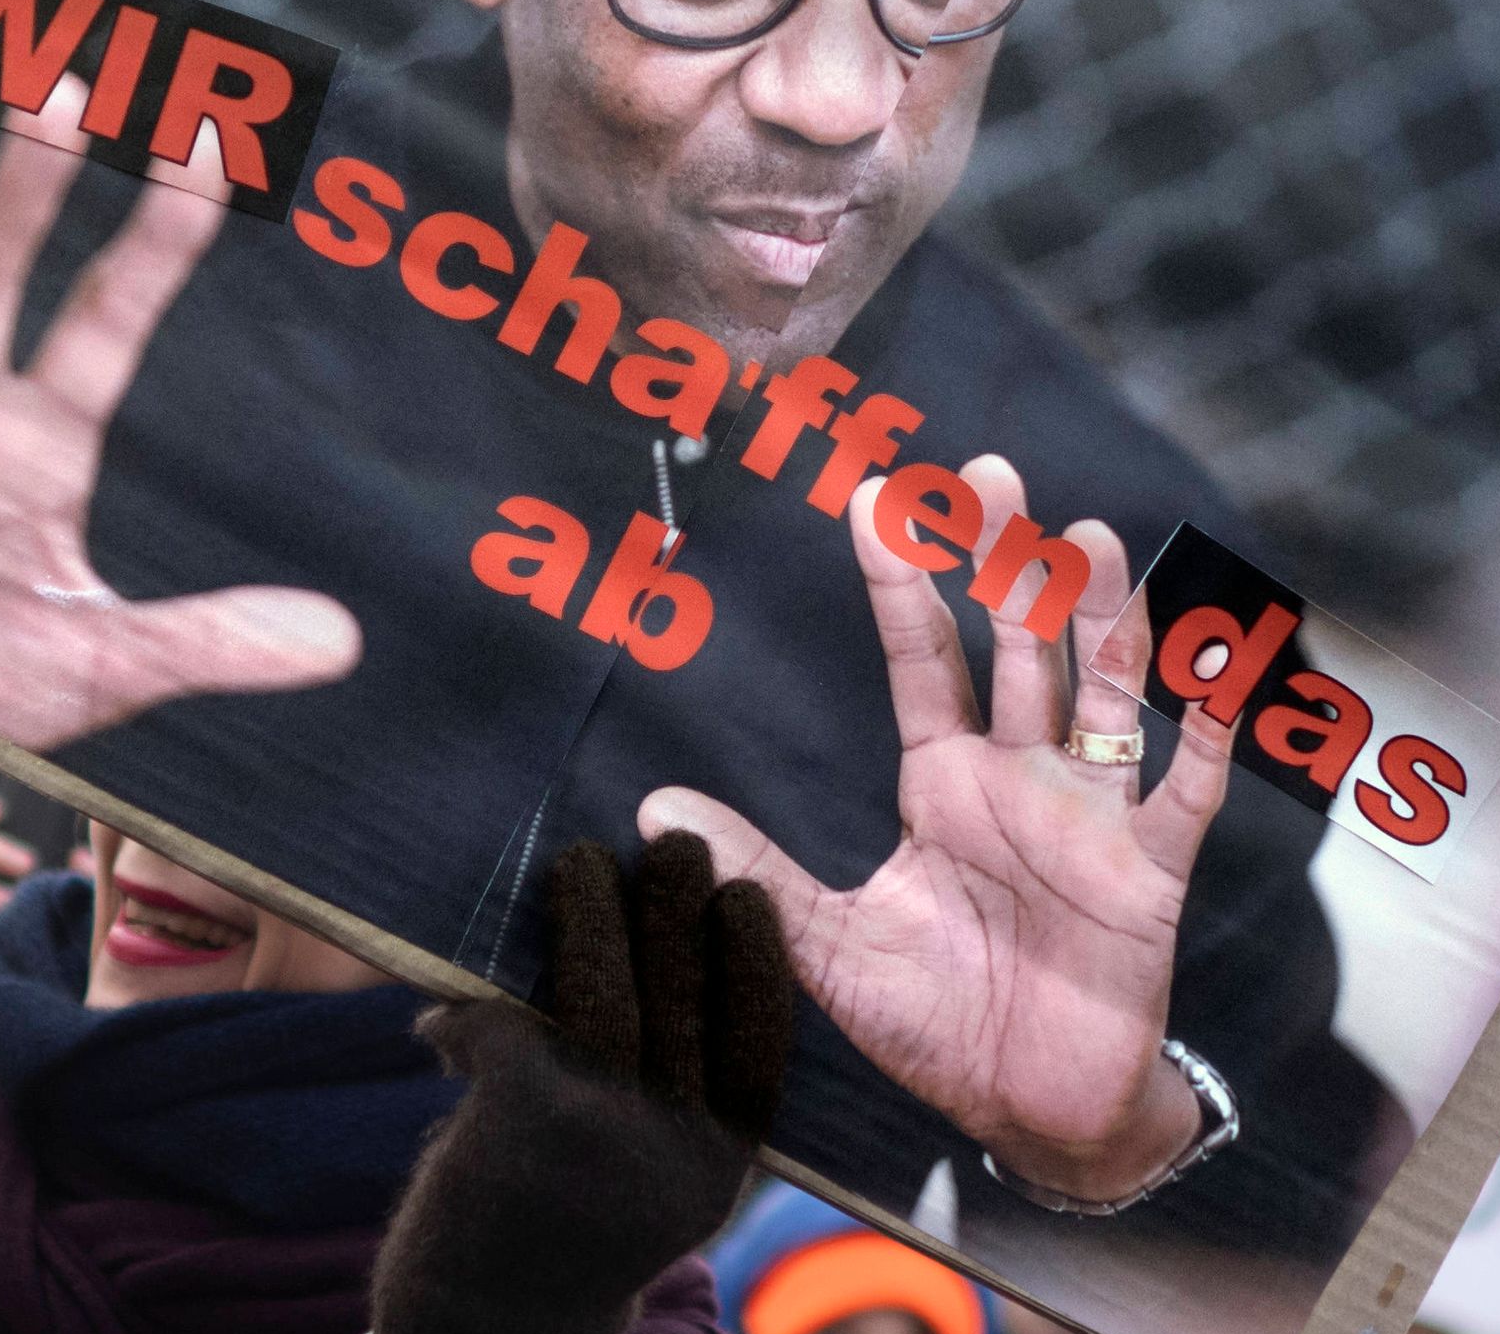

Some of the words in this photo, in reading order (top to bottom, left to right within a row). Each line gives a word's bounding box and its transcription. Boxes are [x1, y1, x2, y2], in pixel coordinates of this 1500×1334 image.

[293, 156, 1093, 645] schaffen
[1157, 603, 1468, 847] das
[470, 495, 714, 672] ab
